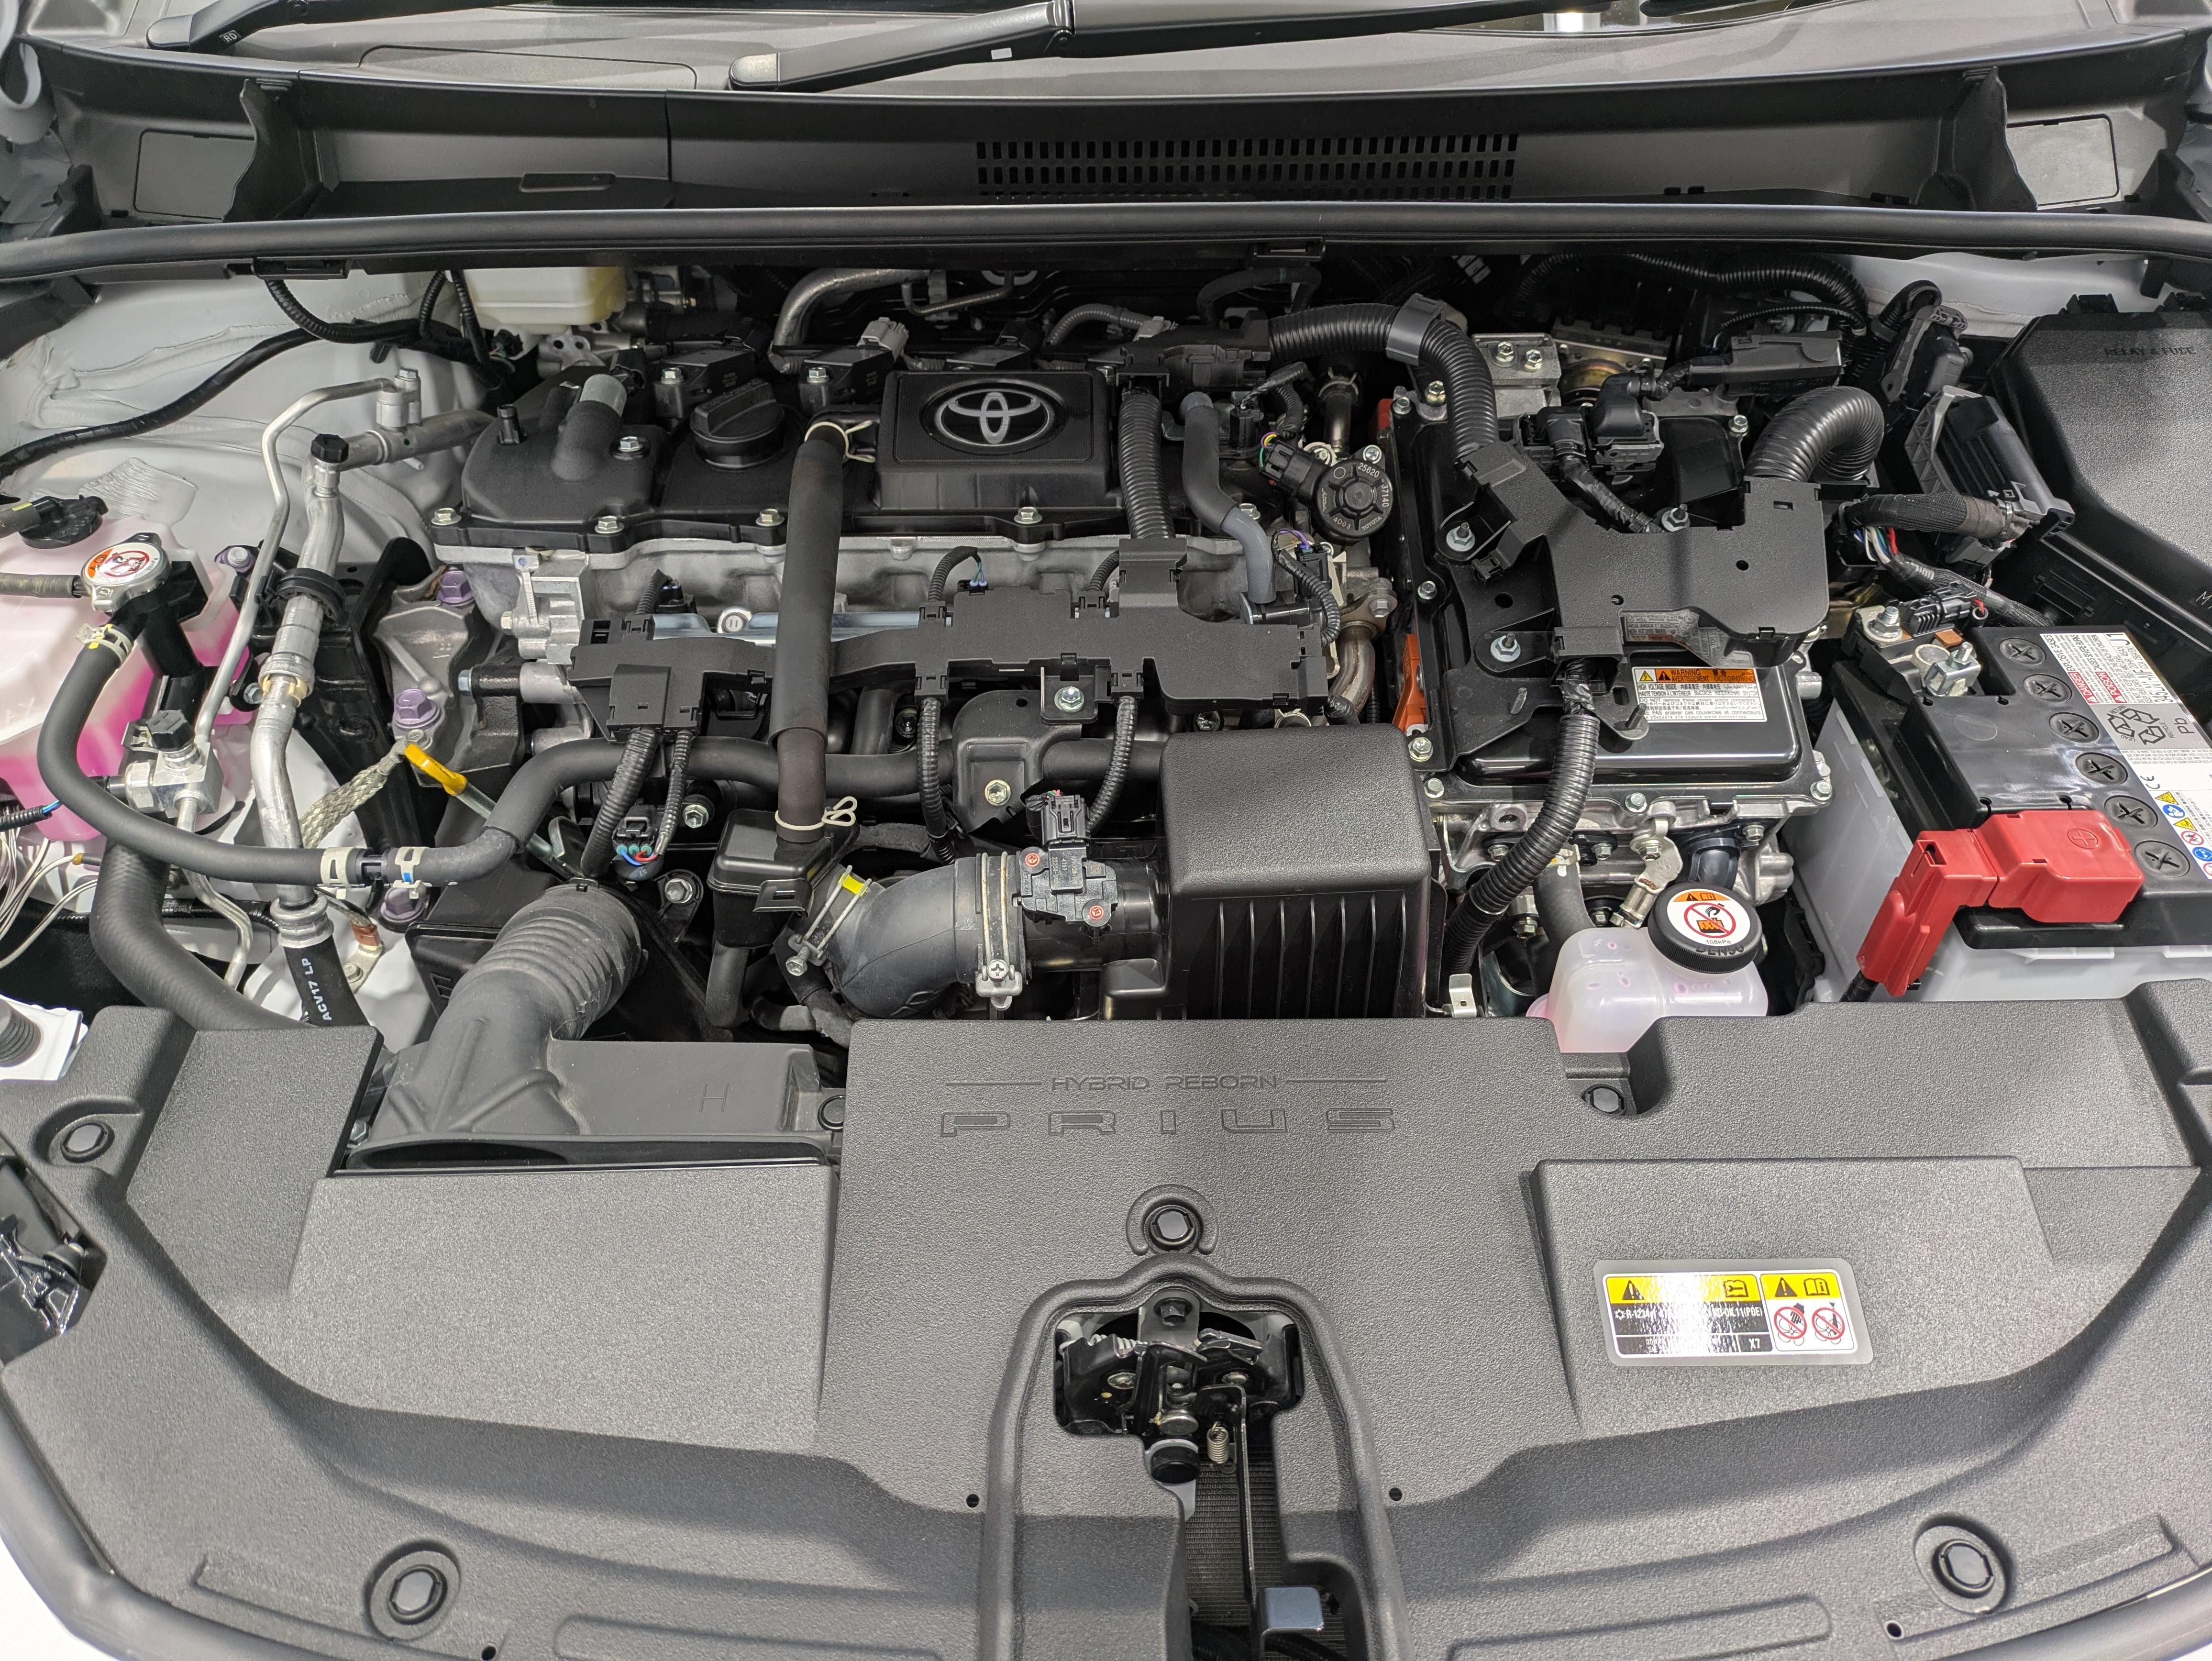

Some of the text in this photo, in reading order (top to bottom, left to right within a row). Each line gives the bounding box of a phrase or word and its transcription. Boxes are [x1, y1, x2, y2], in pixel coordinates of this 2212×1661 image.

[223, 33, 237, 42] RD
[1358, 463, 1380, 478] 25620
[1381, 484, 1390, 508] 37140
[1333, 517, 1351, 530] 4D03
[1361, 516, 1382, 531] TOYOTA
[2042, 635, 2093, 695] DANGER EXPLOSIVE GASES
[2085, 658, 2103, 670] CAUSES
[2096, 672, 2121, 695] POISON
[2131, 669, 2175, 702] 345LN1-MF
[2110, 705, 2127, 715] RETURN
[2159, 721, 2176, 739] RECYCLE
[2174, 718, 2195, 734] Pb
[1696, 944, 1744, 956] DENSO
[301, 958, 332, 1020] ACV17 LP
[1052, 1075, 1277, 1090] HYBRID REBORN
[940, 1108, 1395, 1137] PRIUS
[1748, 1338, 1761, 1349] X7
